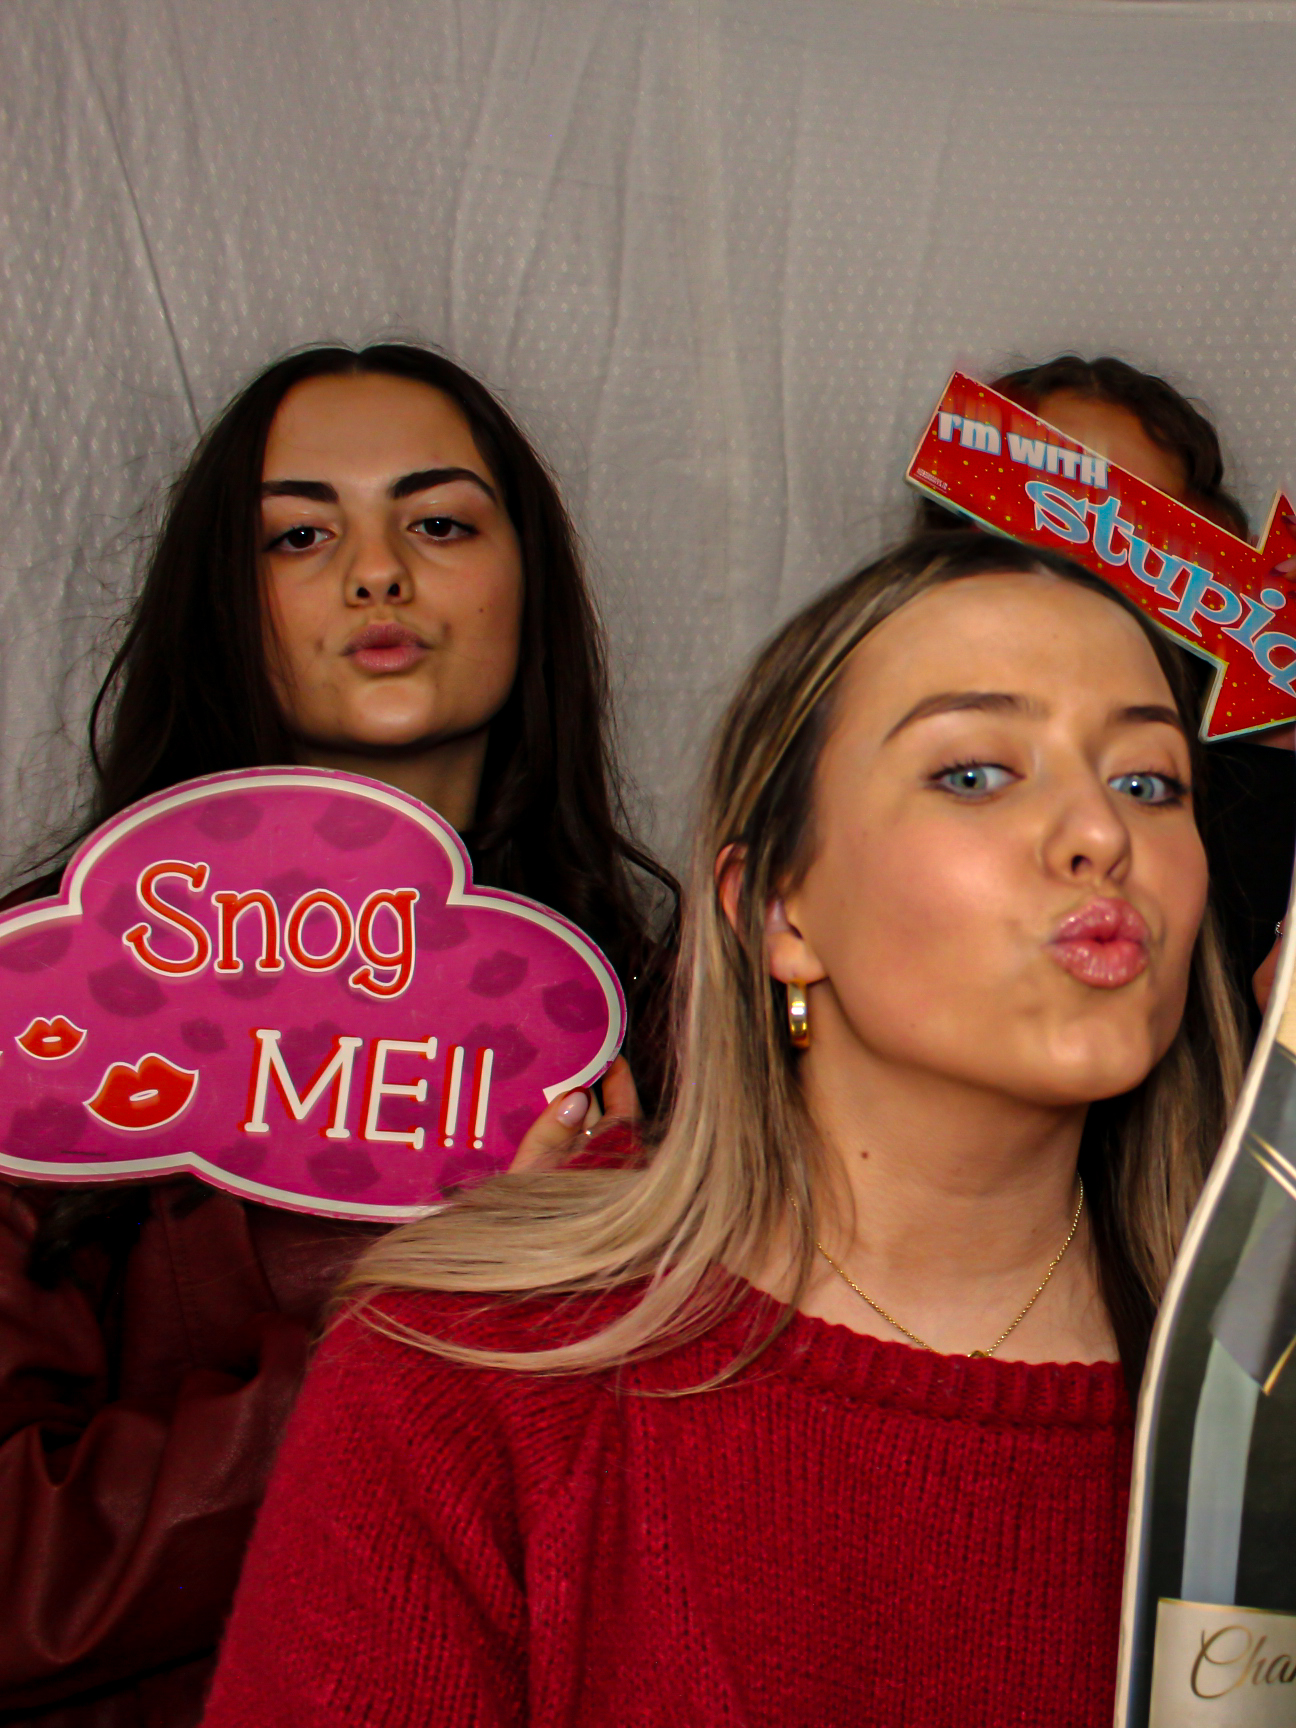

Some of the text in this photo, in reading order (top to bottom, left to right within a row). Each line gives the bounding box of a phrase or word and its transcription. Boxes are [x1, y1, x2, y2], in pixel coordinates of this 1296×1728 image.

[1006, 432, 1108, 490] WITH
[123, 860, 419, 999] Snog
[242, 1028, 494, 1150] ME!!
